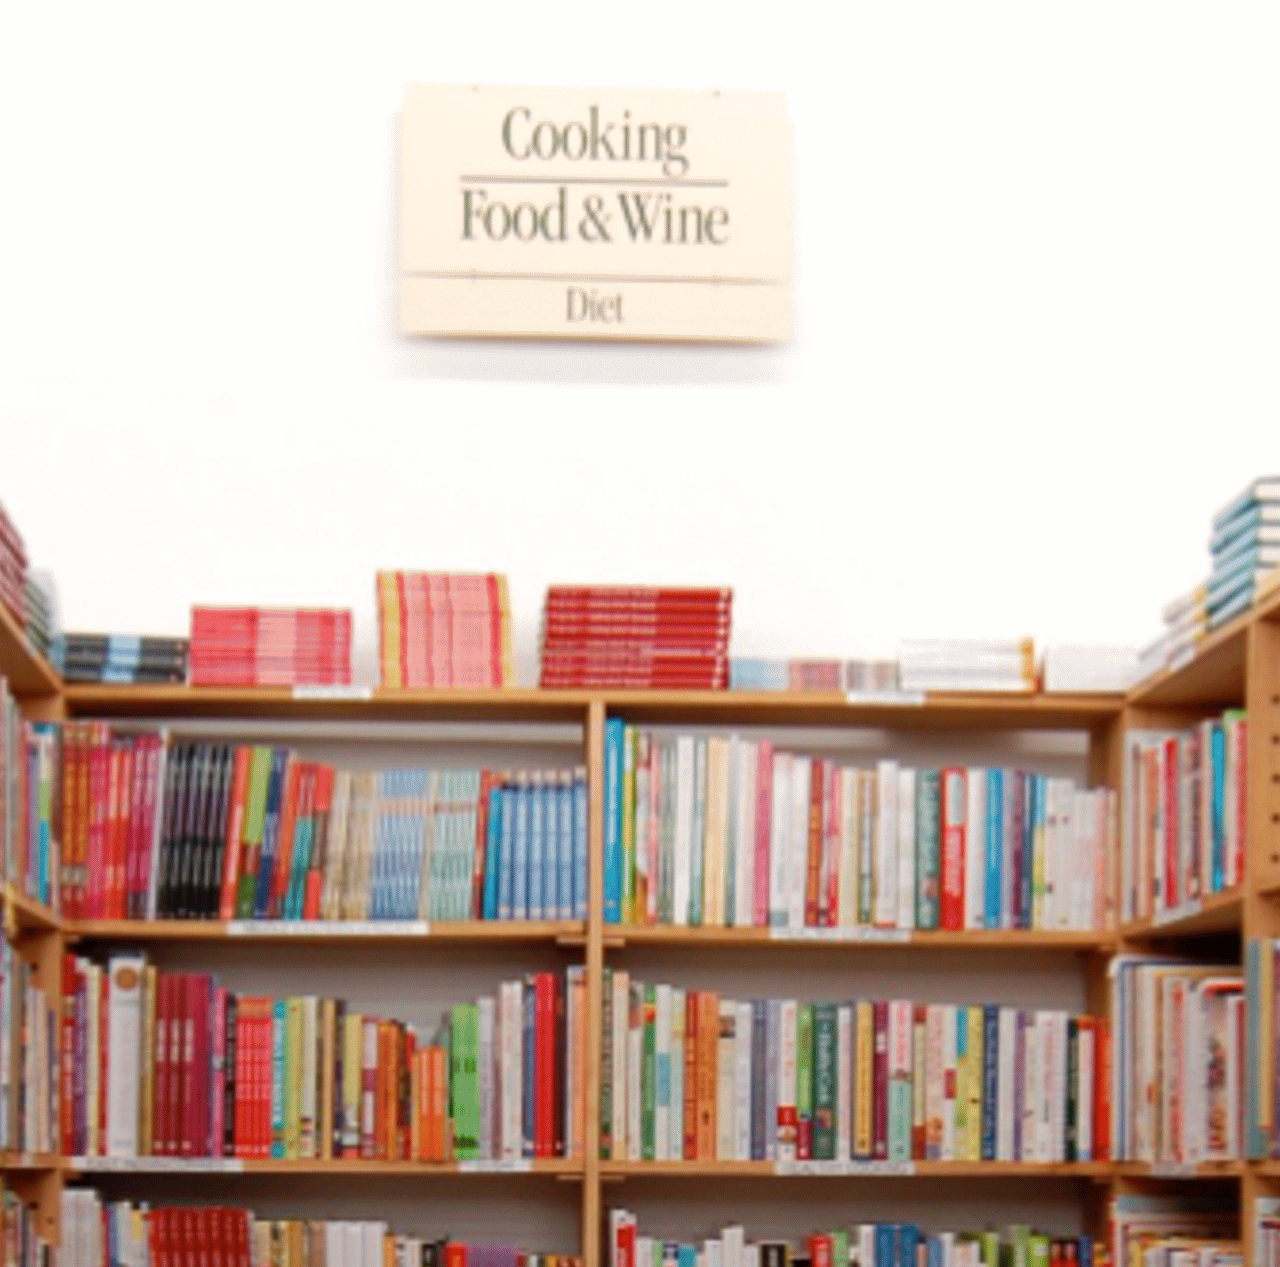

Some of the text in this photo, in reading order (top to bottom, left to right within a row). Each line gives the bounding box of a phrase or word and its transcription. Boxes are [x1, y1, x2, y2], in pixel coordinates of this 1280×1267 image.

[501, 104, 691, 181] Cooking
[460, 187, 730, 245] Food & Wine
[565, 285, 625, 323] Diet
